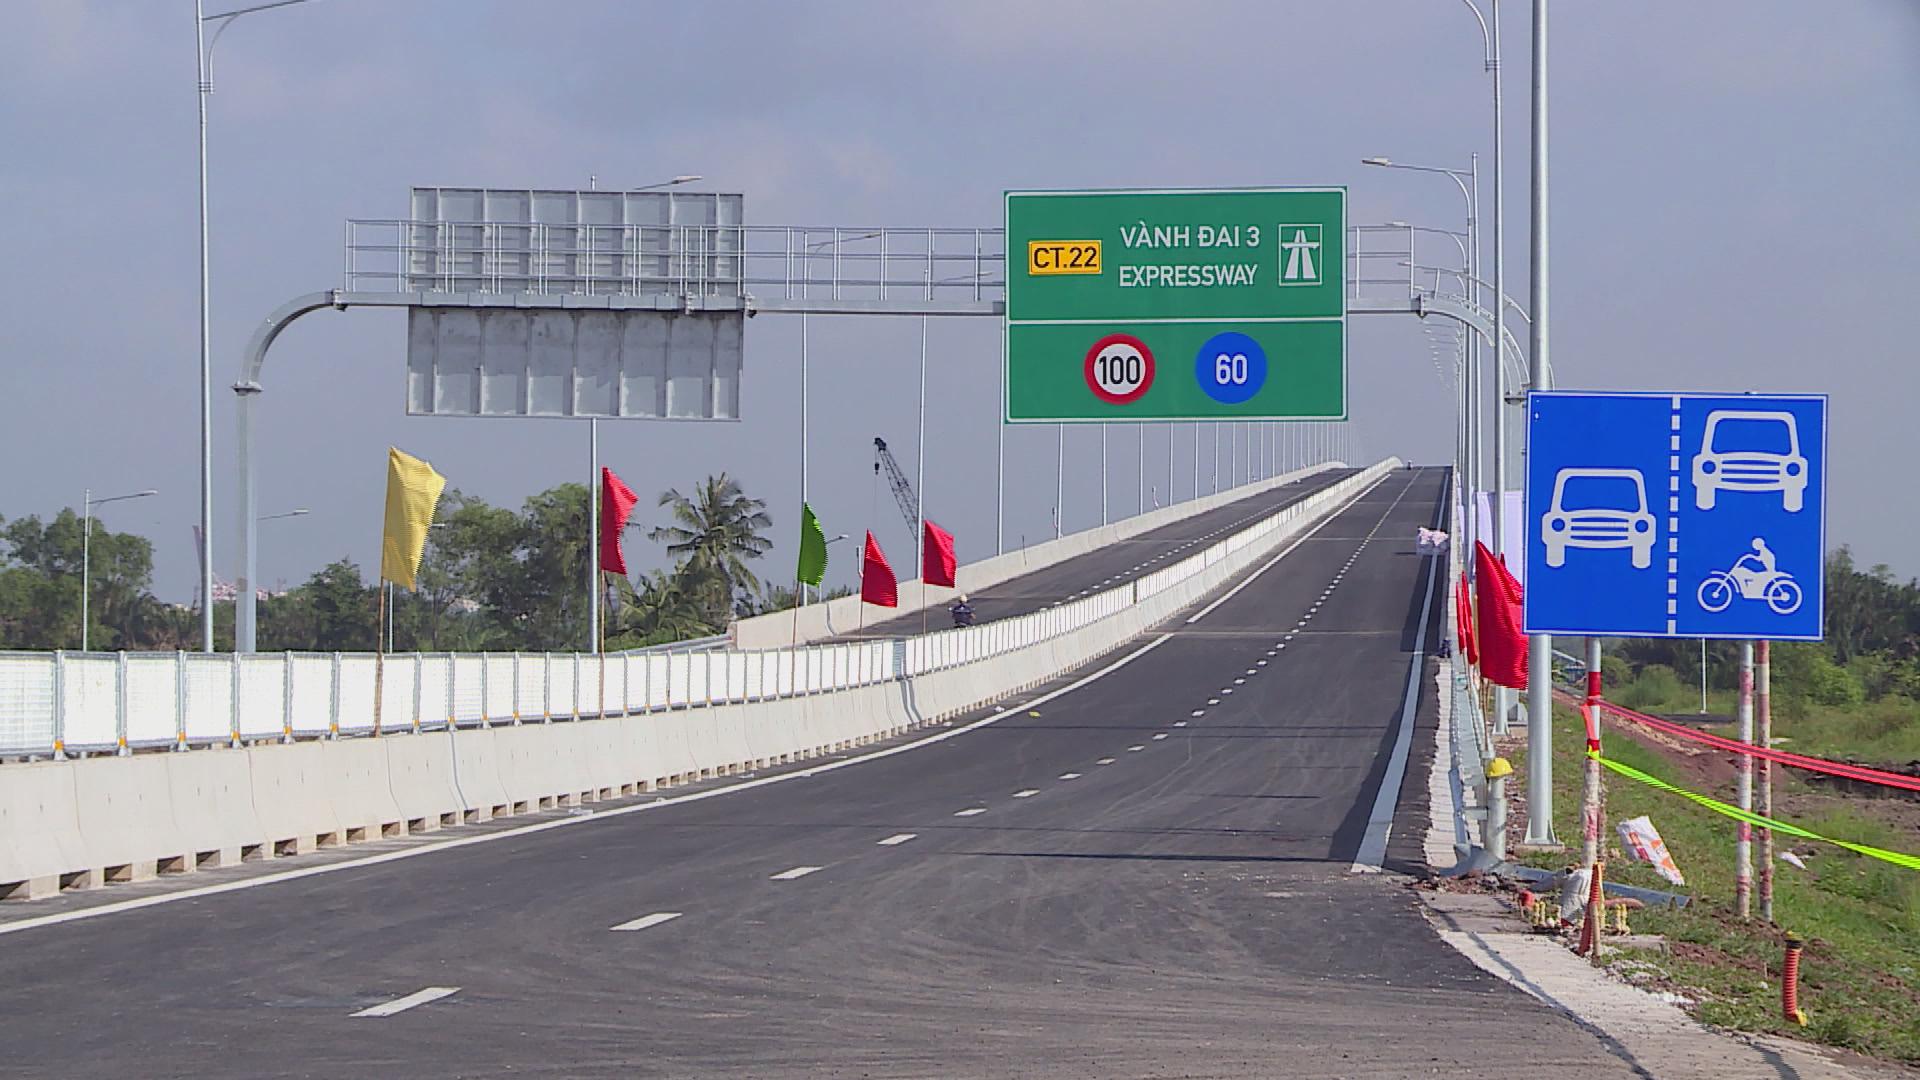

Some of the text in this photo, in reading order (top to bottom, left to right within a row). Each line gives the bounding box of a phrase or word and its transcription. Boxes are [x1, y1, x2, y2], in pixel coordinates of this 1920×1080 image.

[1120, 221, 1260, 248] VÀNH ĐAI 3
[1033, 247, 1098, 269] CT.22
[1119, 264, 1258, 287] EXPRESSWAY
[1098, 355, 1141, 385] 100
[1215, 354, 1248, 385] 60
